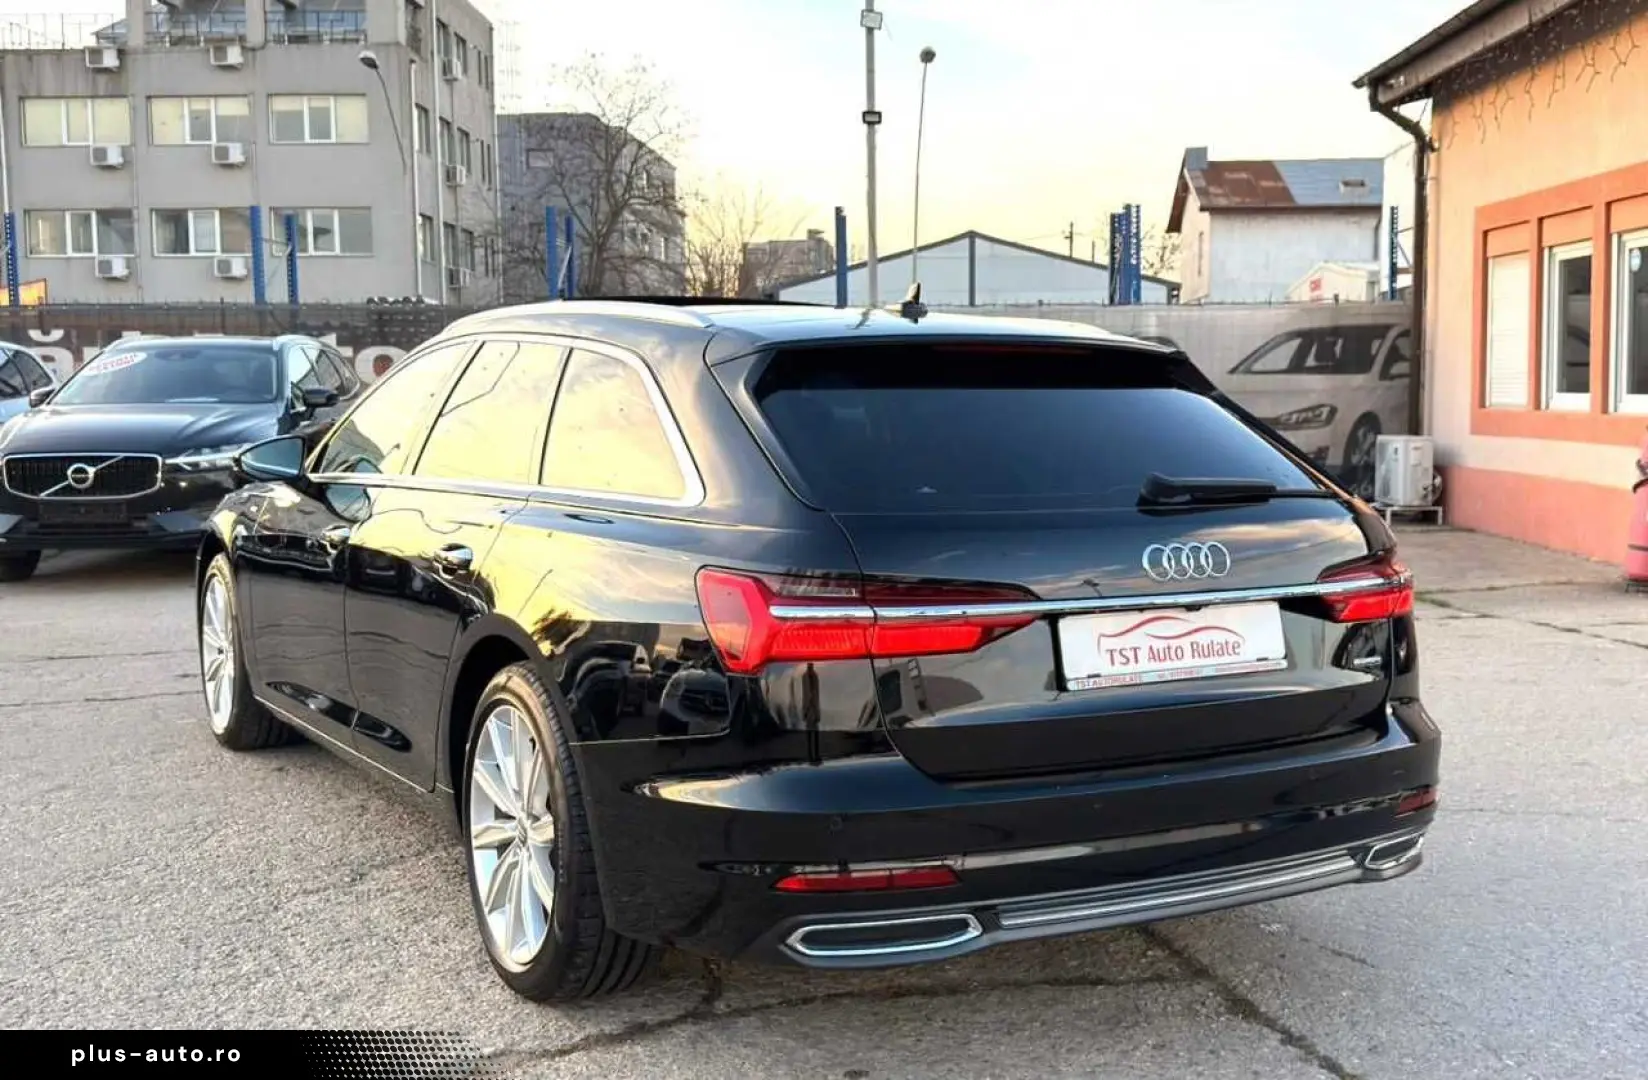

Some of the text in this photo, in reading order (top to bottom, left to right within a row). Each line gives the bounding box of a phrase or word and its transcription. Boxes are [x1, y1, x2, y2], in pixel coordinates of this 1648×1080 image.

[1106, 639, 1242, 667] TST Auto Rulate
